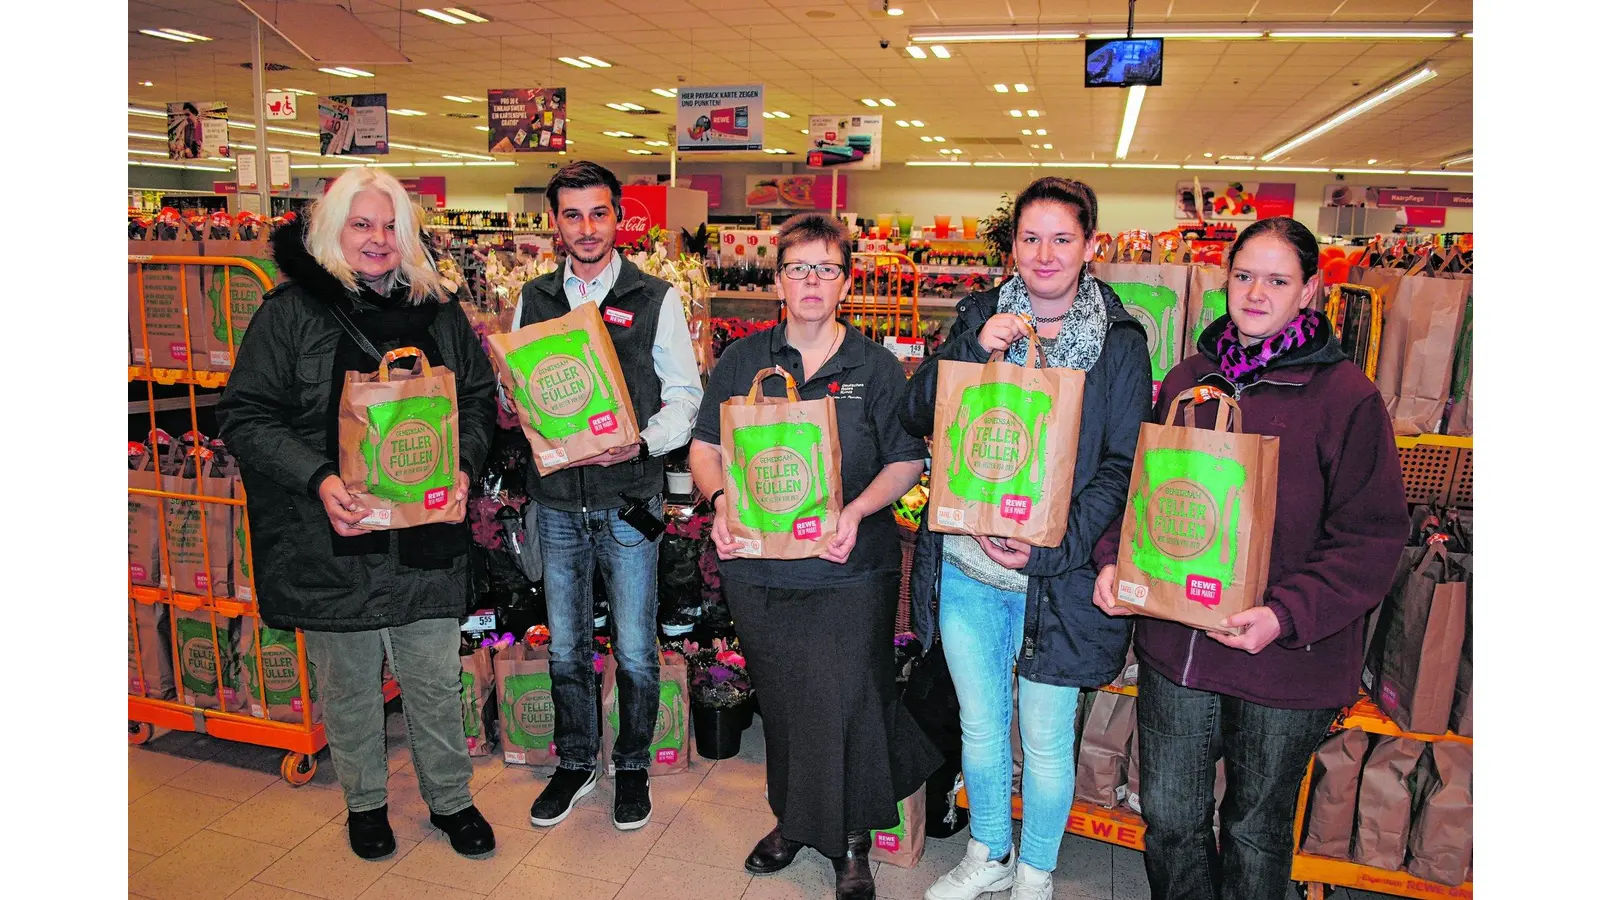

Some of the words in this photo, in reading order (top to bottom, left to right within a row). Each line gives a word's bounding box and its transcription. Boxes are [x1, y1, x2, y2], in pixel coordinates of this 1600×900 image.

[681, 92, 694, 100] HIER
[738, 90, 758, 98] ZEIGEN
[1391, 194, 1424, 202] Haarpflege
[230, 290, 257, 301] ELLER
[539, 360, 569, 375] GEMEINSAM
[537, 366, 580, 391] TELLER
[541, 378, 586, 405] FÜLLEN
[592, 414, 612, 425] REWE
[976, 426, 1020, 445] TELLER
[391, 435, 432, 454] TELLER
[390, 450, 432, 469] FÜLLEN
[760, 455, 792, 463] GEMEINSAM
[972, 442, 1019, 463] FÜLLEN
[755, 464, 799, 479] TELLER
[756, 478, 801, 495] FÜLLEN
[1165, 488, 1201, 499] GEMEINSAM
[428, 490, 444, 499] REWE
[1006, 499, 1026, 507] REWE
[1158, 497, 1207, 520] TELLER
[796, 520, 817, 529] REWE
[1154, 516, 1207, 539] FÜLLEN
[1191, 580, 1216, 591] REWE
[1190, 588, 1201, 596] DEIN
[1201, 590, 1215, 599] MARKT
[263, 658, 292, 667] ELLER
[1067, 816, 1136, 844] EWE
[1407, 880, 1444, 894] REWE
